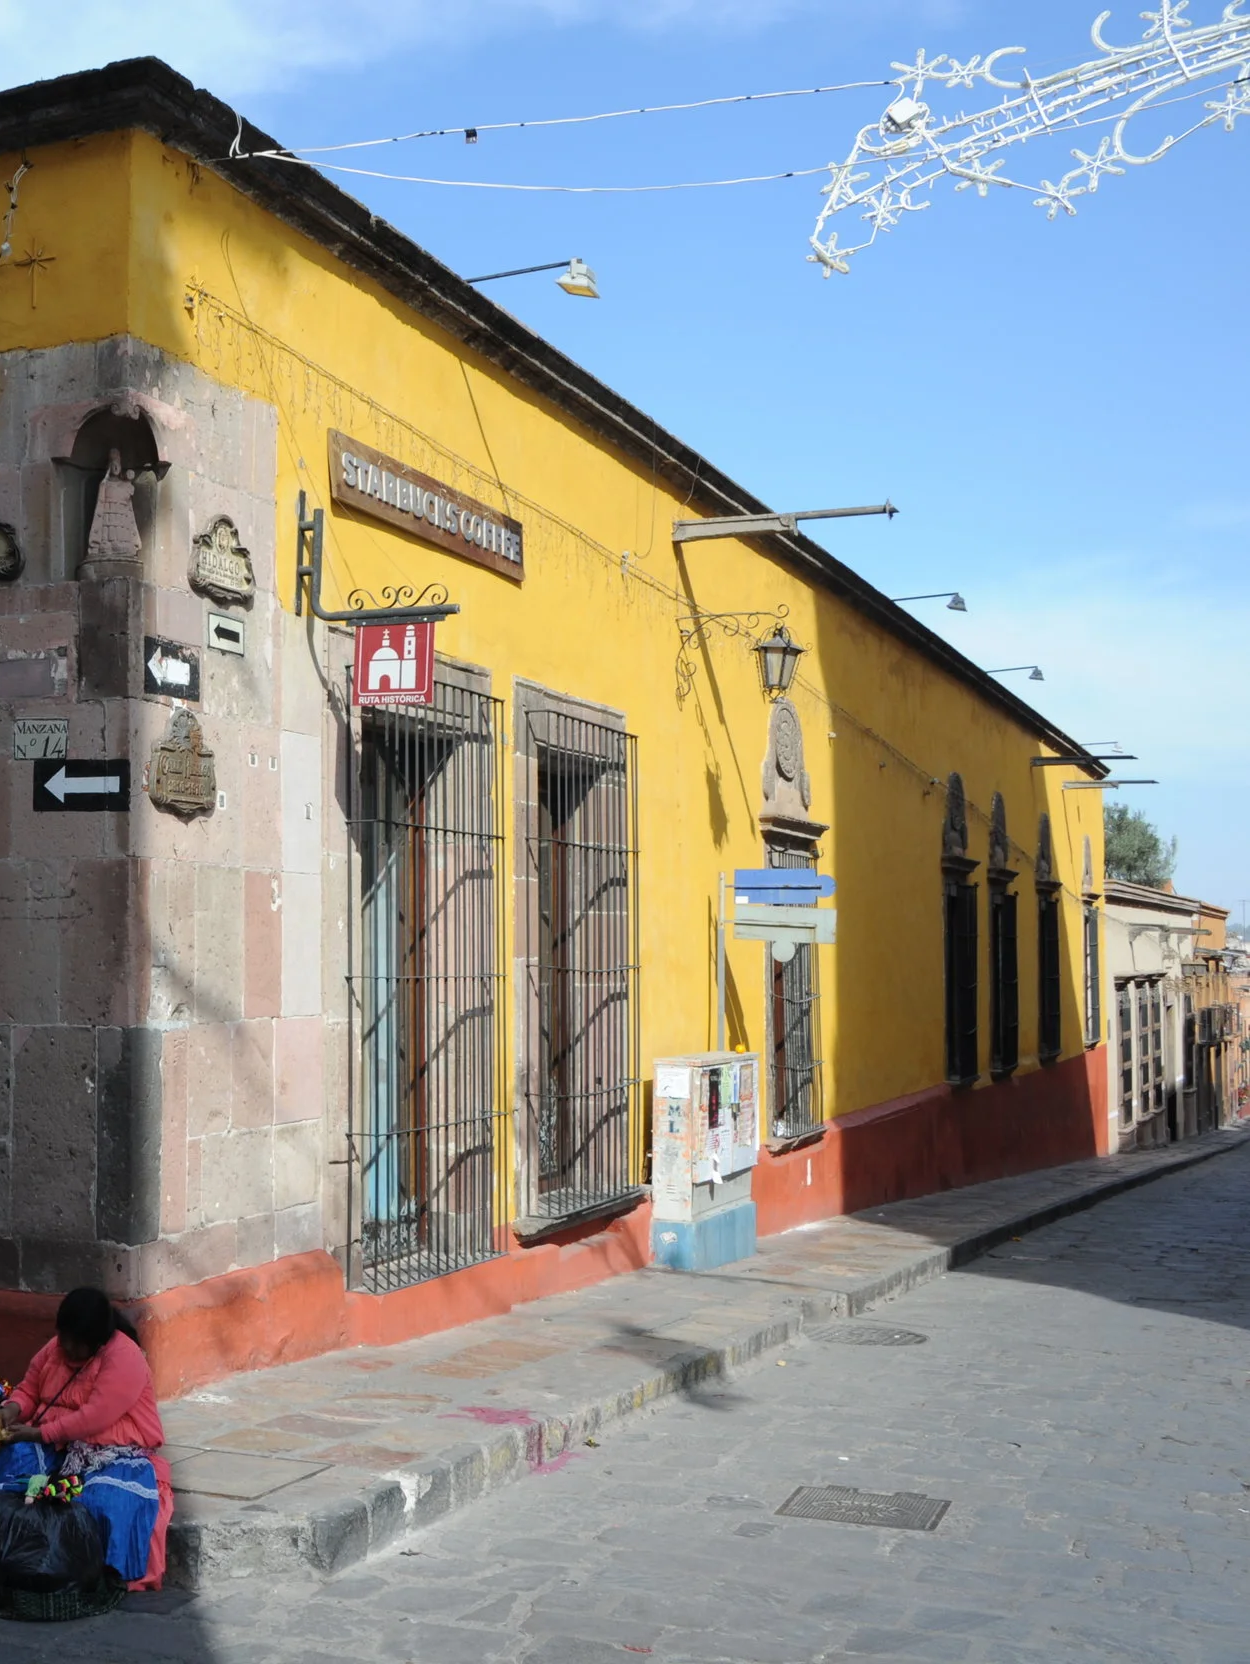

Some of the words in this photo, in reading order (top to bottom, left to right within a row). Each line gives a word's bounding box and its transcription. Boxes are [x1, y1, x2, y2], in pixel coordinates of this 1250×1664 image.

[341, 451, 458, 535] STARBUCKS
[460, 509, 521, 565] COFFEE
[201, 550, 240, 576] HIDALGO
[358, 696, 380, 704] RUTA
[381, 694, 426, 704] HISTÓRICA
[16, 721, 68, 735] MANZANA
